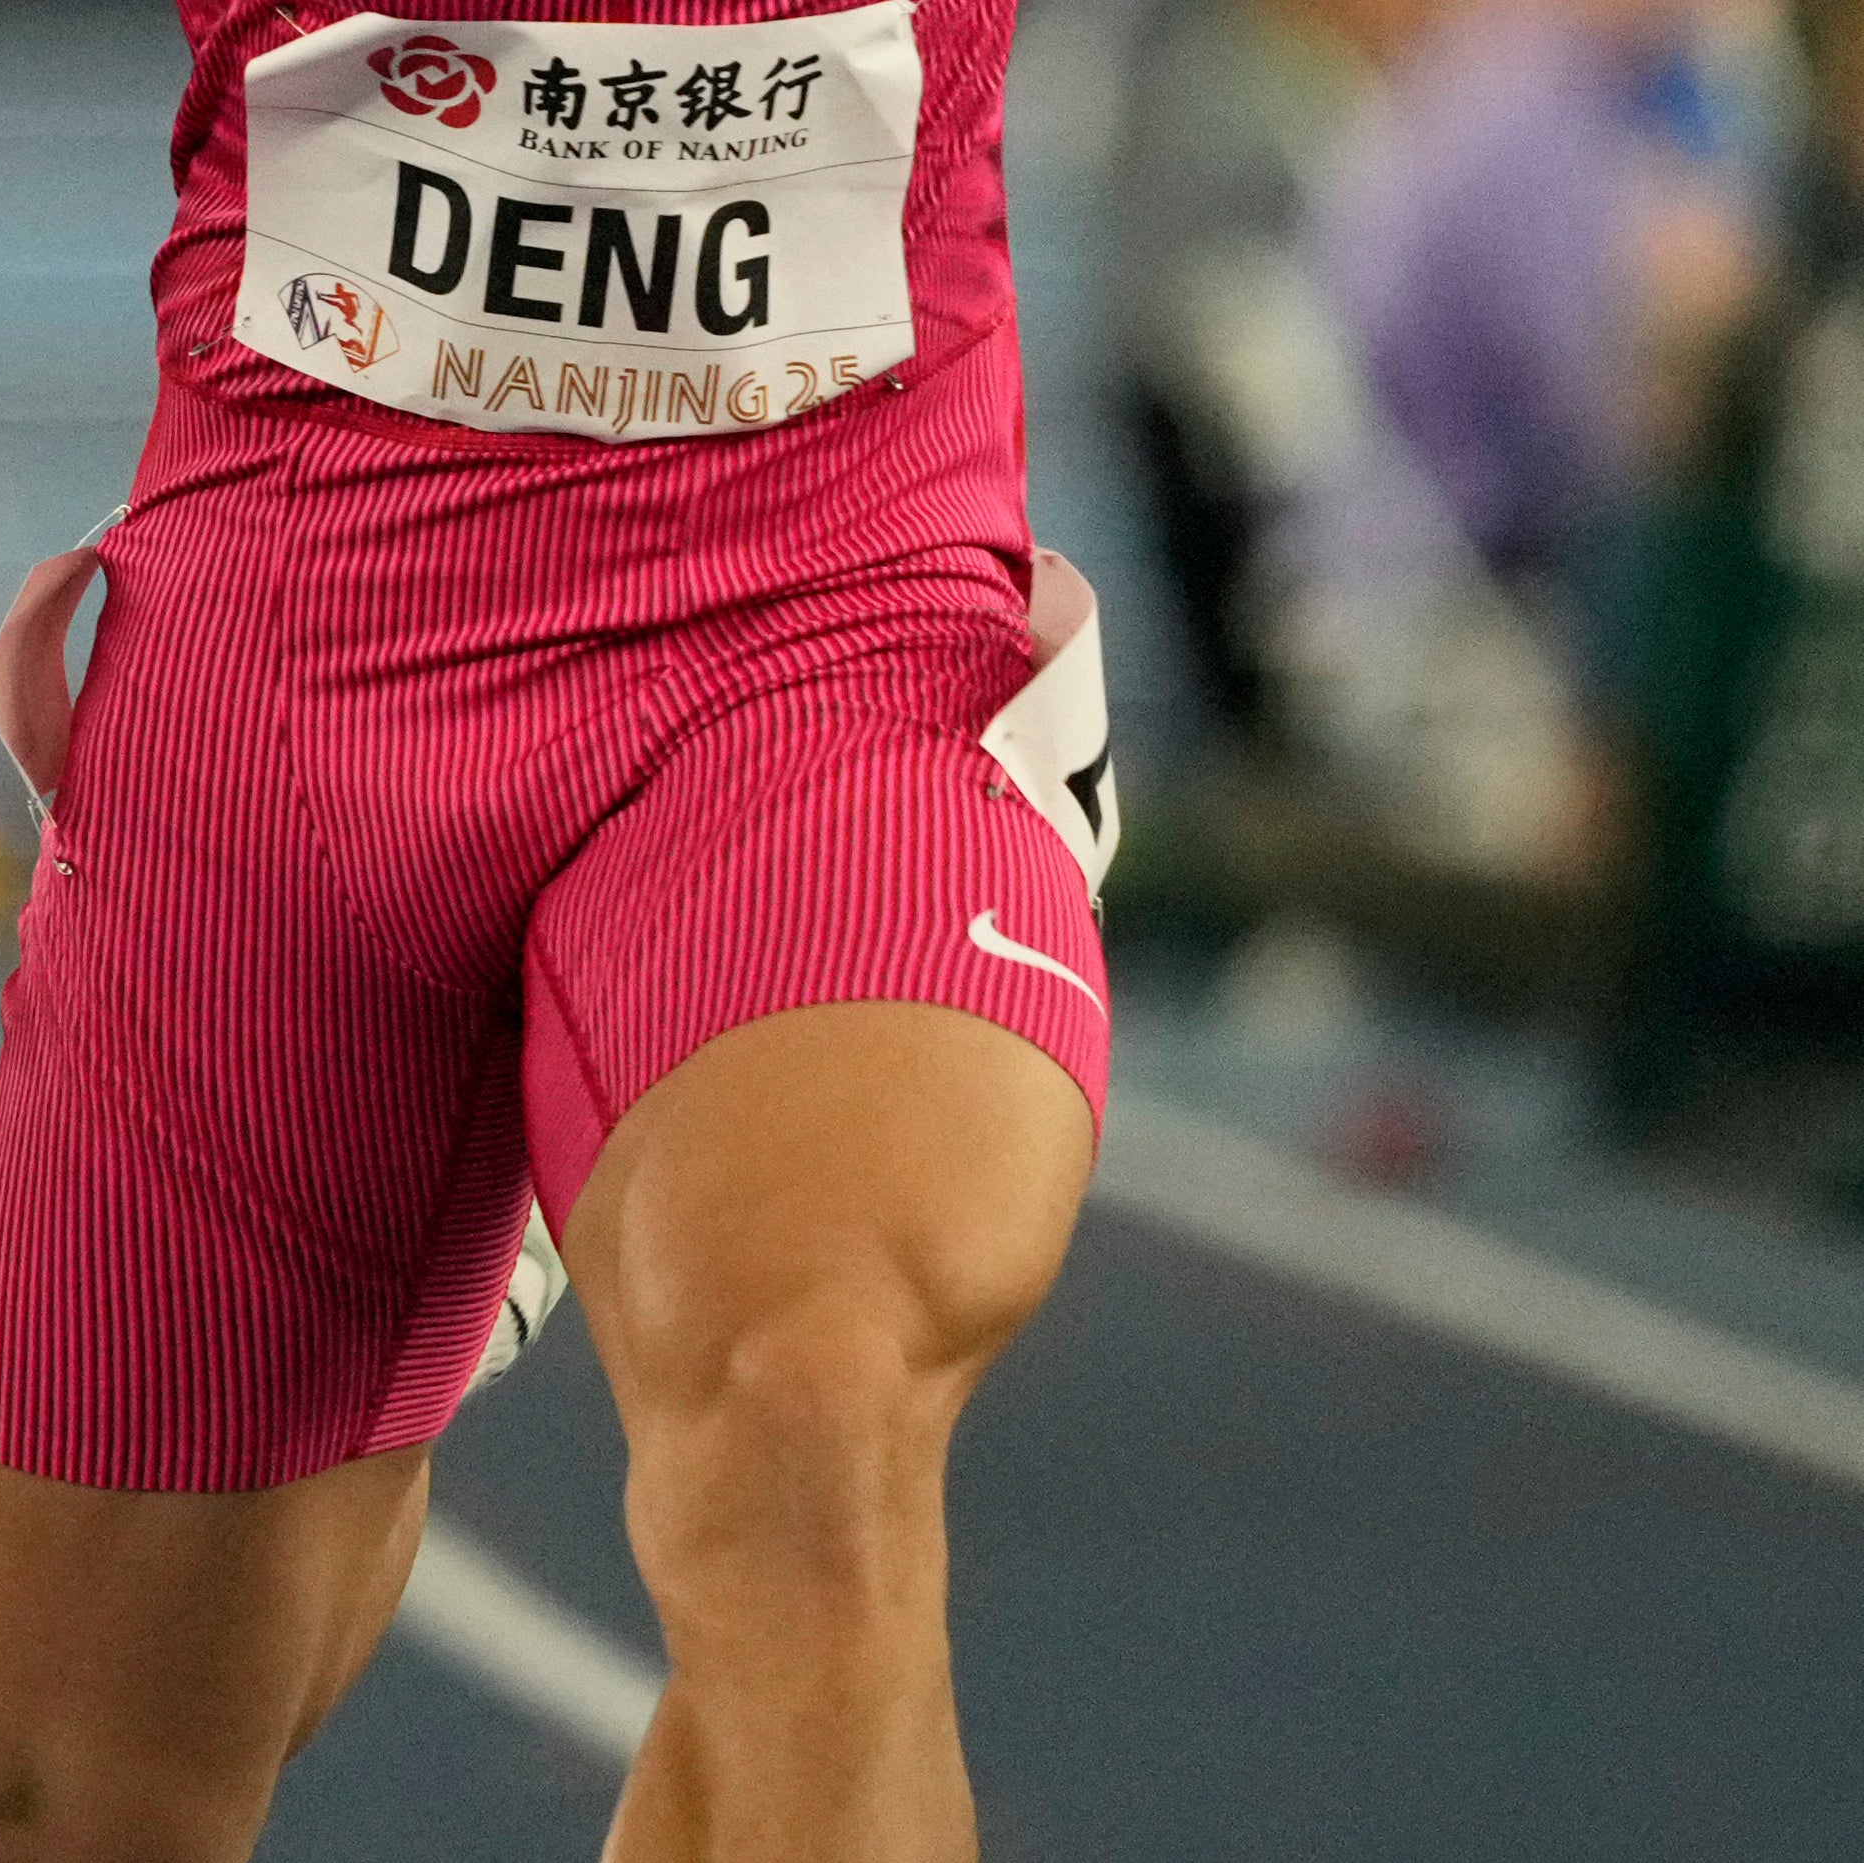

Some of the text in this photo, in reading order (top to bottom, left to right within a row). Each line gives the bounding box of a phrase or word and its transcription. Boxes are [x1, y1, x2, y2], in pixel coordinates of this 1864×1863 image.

[522, 53, 824, 132] 南京银行
[518, 128, 810, 162] BANK OF NANJING
[386, 160, 771, 337] DENG
